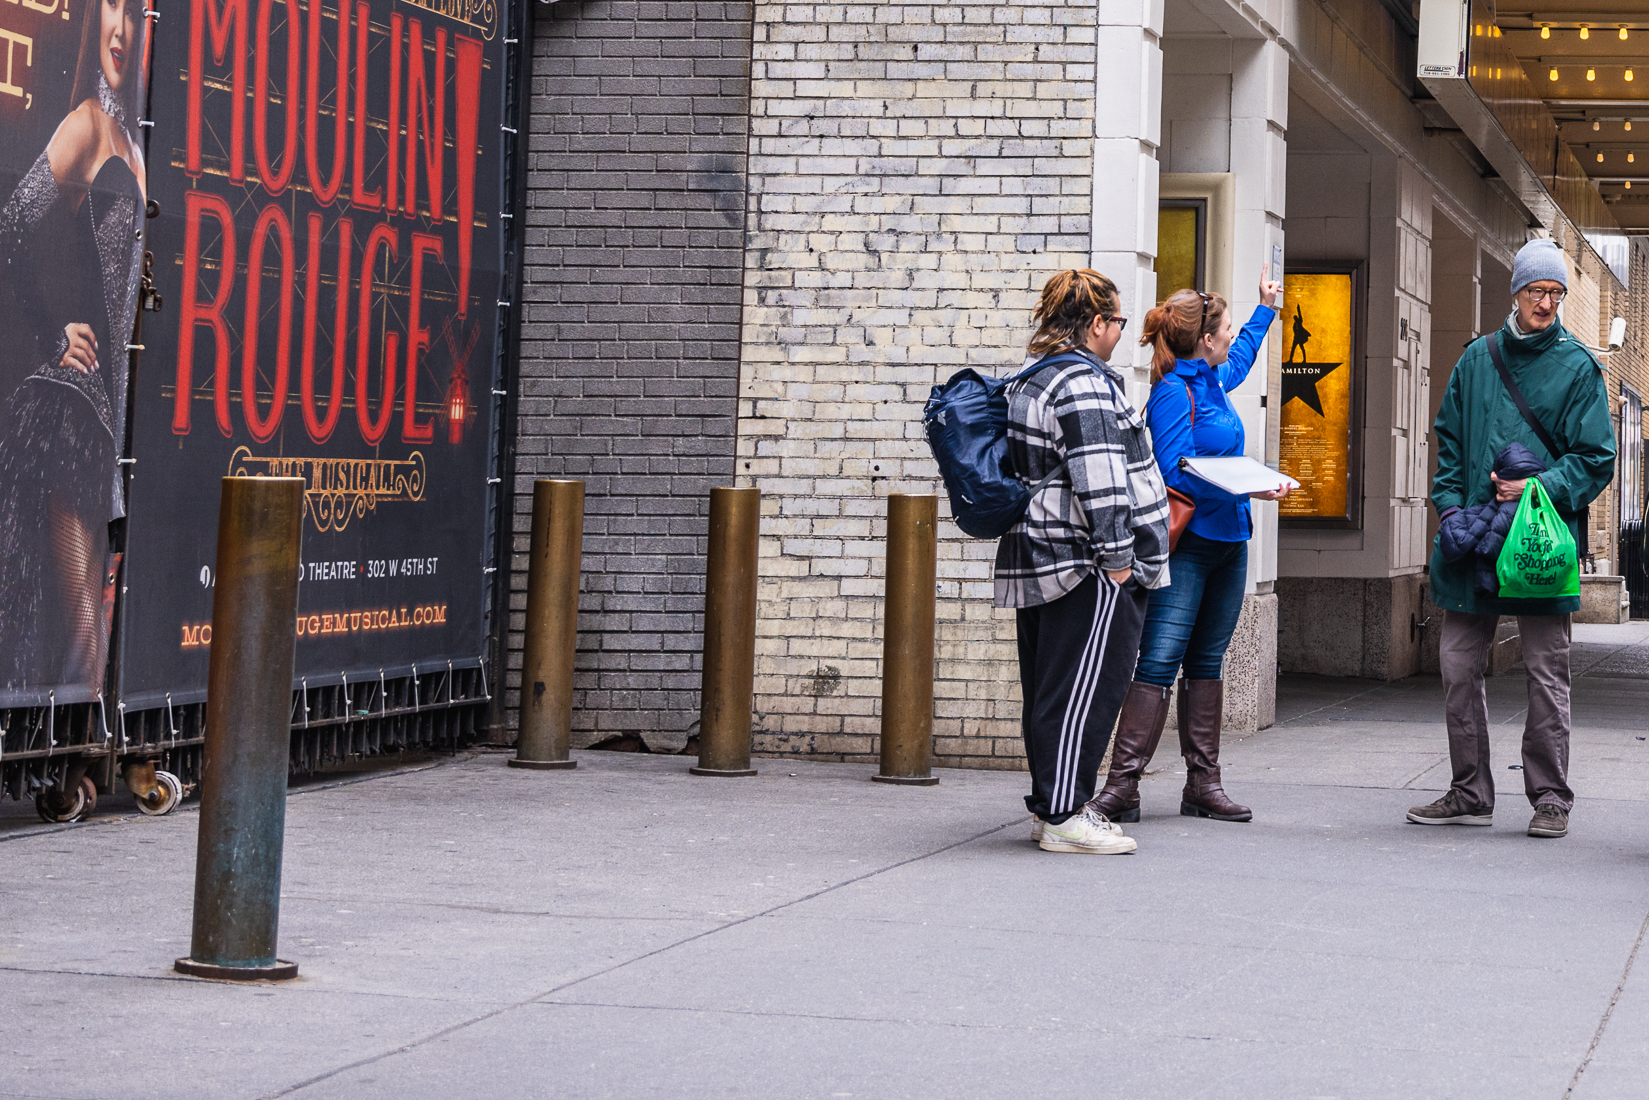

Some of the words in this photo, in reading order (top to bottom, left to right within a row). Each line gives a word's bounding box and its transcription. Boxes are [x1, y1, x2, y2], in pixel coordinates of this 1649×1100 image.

[172, 190, 444, 445] ROUGE
[311, 459, 395, 493] MUSICAL!
[308, 560, 357, 581] THEATRE
[367, 560, 385, 578] 302
[388, 559, 398, 577] W
[400, 558, 424, 576] 45TH
[426, 557, 438, 575] ST
[181, 605, 447, 646] MOUGEMUSICAL.COM
